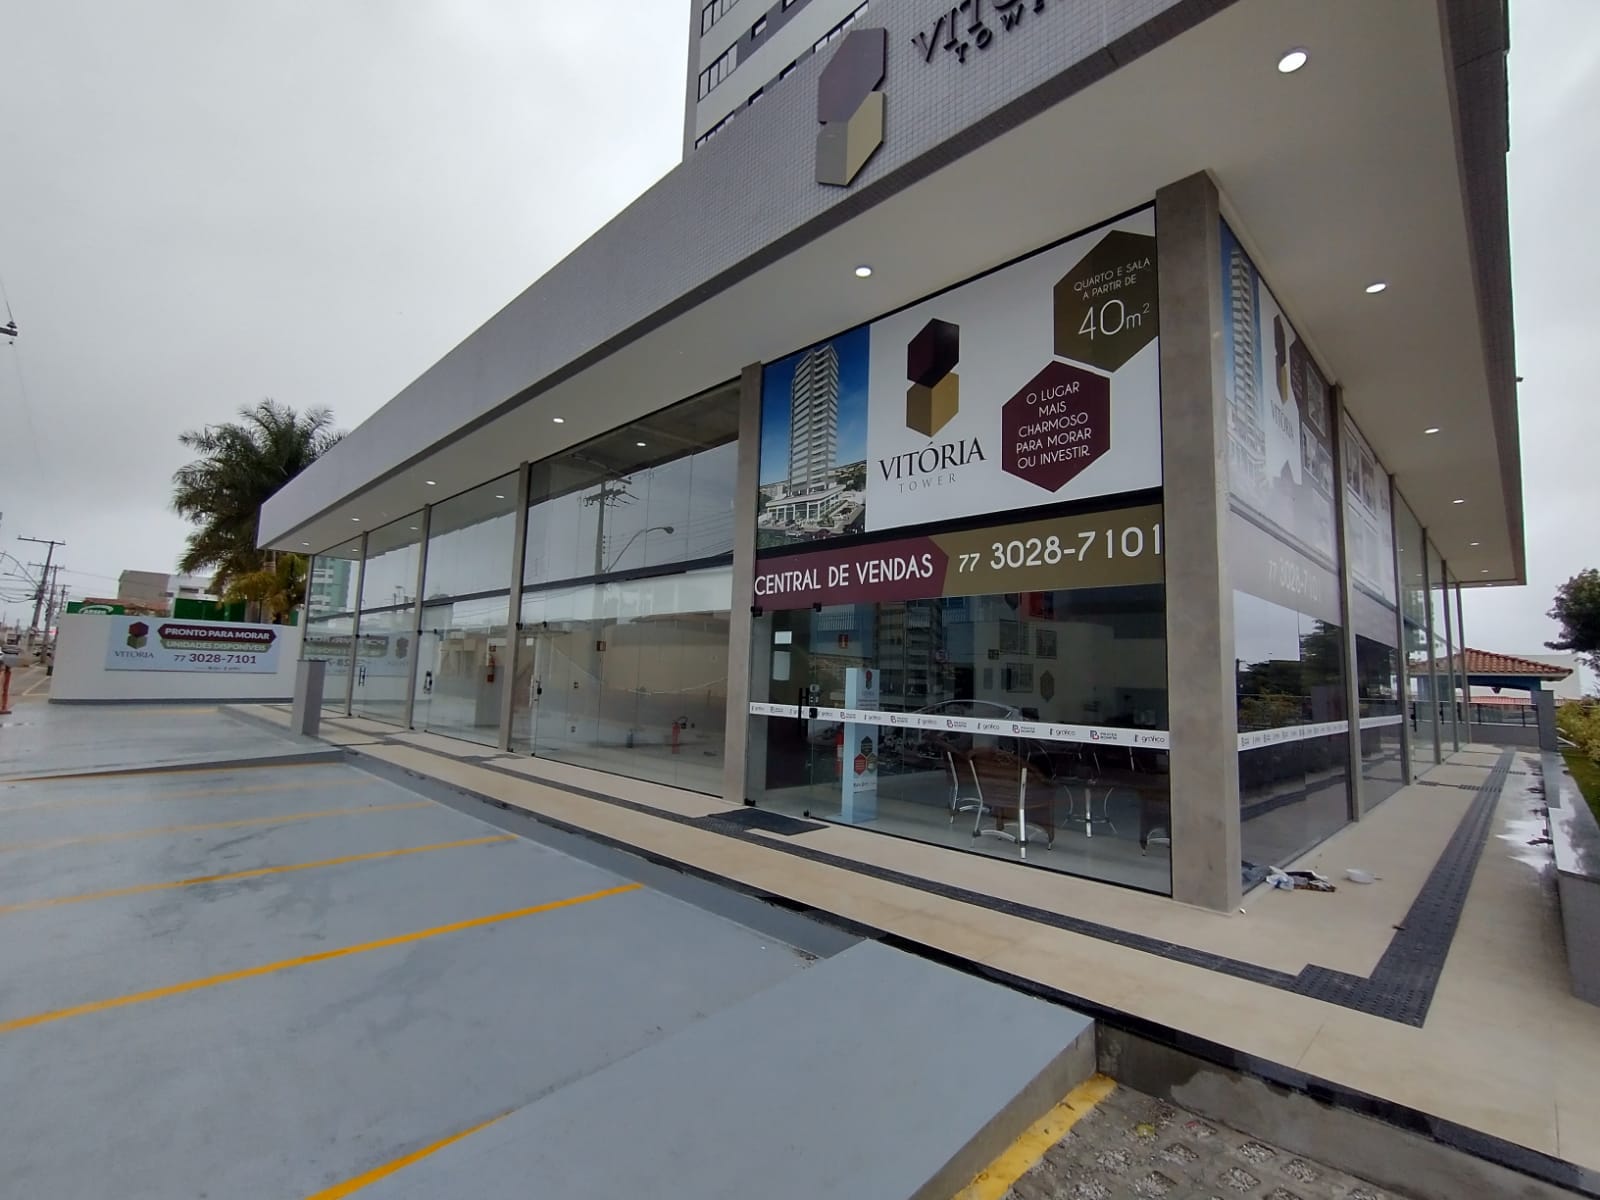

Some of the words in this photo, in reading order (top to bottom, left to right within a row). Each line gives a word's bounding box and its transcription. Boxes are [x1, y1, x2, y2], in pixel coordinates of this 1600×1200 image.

[911, 0, 1019, 63] VIT
[1073, 270, 1114, 292] QUARTO
[1117, 266, 1123, 277] E
[1126, 257, 1151, 273] SALA
[1082, 291, 1089, 301] A
[1092, 280, 1122, 297] PARTIR
[1125, 274, 1137, 286] DE
[1026, 392, 1037, 405] O
[1041, 381, 1080, 402] LUGAR
[1038, 401, 1067, 418] MAIS
[1018, 412, 1089, 438] CHARMOSO
[1016, 439, 1043, 454] PARA
[1047, 427, 1092, 448] MORAR
[877, 436, 987, 481] VITÓRIA
[1017, 455, 1036, 469] OU
[898, 472, 957, 494] TOWER
[754, 568, 821, 596] CENTRAL
[828, 564, 849, 588] DE
[856, 553, 934, 585] VENDAS
[958, 552, 981, 573] 77
[990, 523, 1160, 570] 3028-7101
[165, 627, 207, 637] PRONTO
[208, 630, 234, 638] PARA
[235, 631, 270, 640] MORAR
[174, 654, 187, 662] 77
[189, 653, 257, 664] 3028-7101
